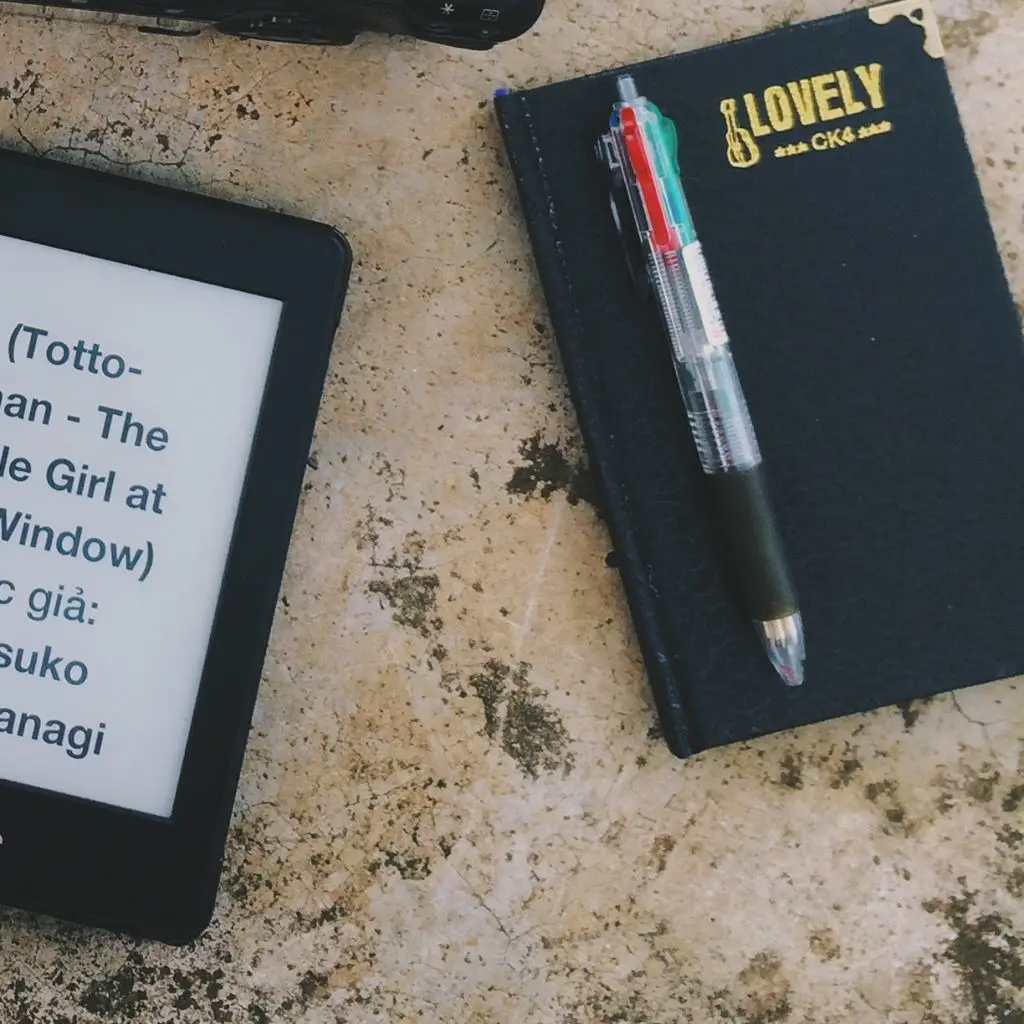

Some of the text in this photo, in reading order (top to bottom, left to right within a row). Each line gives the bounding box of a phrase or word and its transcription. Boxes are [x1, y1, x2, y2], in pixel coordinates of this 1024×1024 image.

[743, 63, 885, 137] LOVELY
[811, 126, 856, 151] CK4
[8, 323, 142, 379] (Totto-
[66, 414, 81, 424] -
[97, 405, 169, 452] The
[46, 458, 116, 503] Girl
[125, 483, 167, 515] at
[26, 584, 99, 626] giả:
